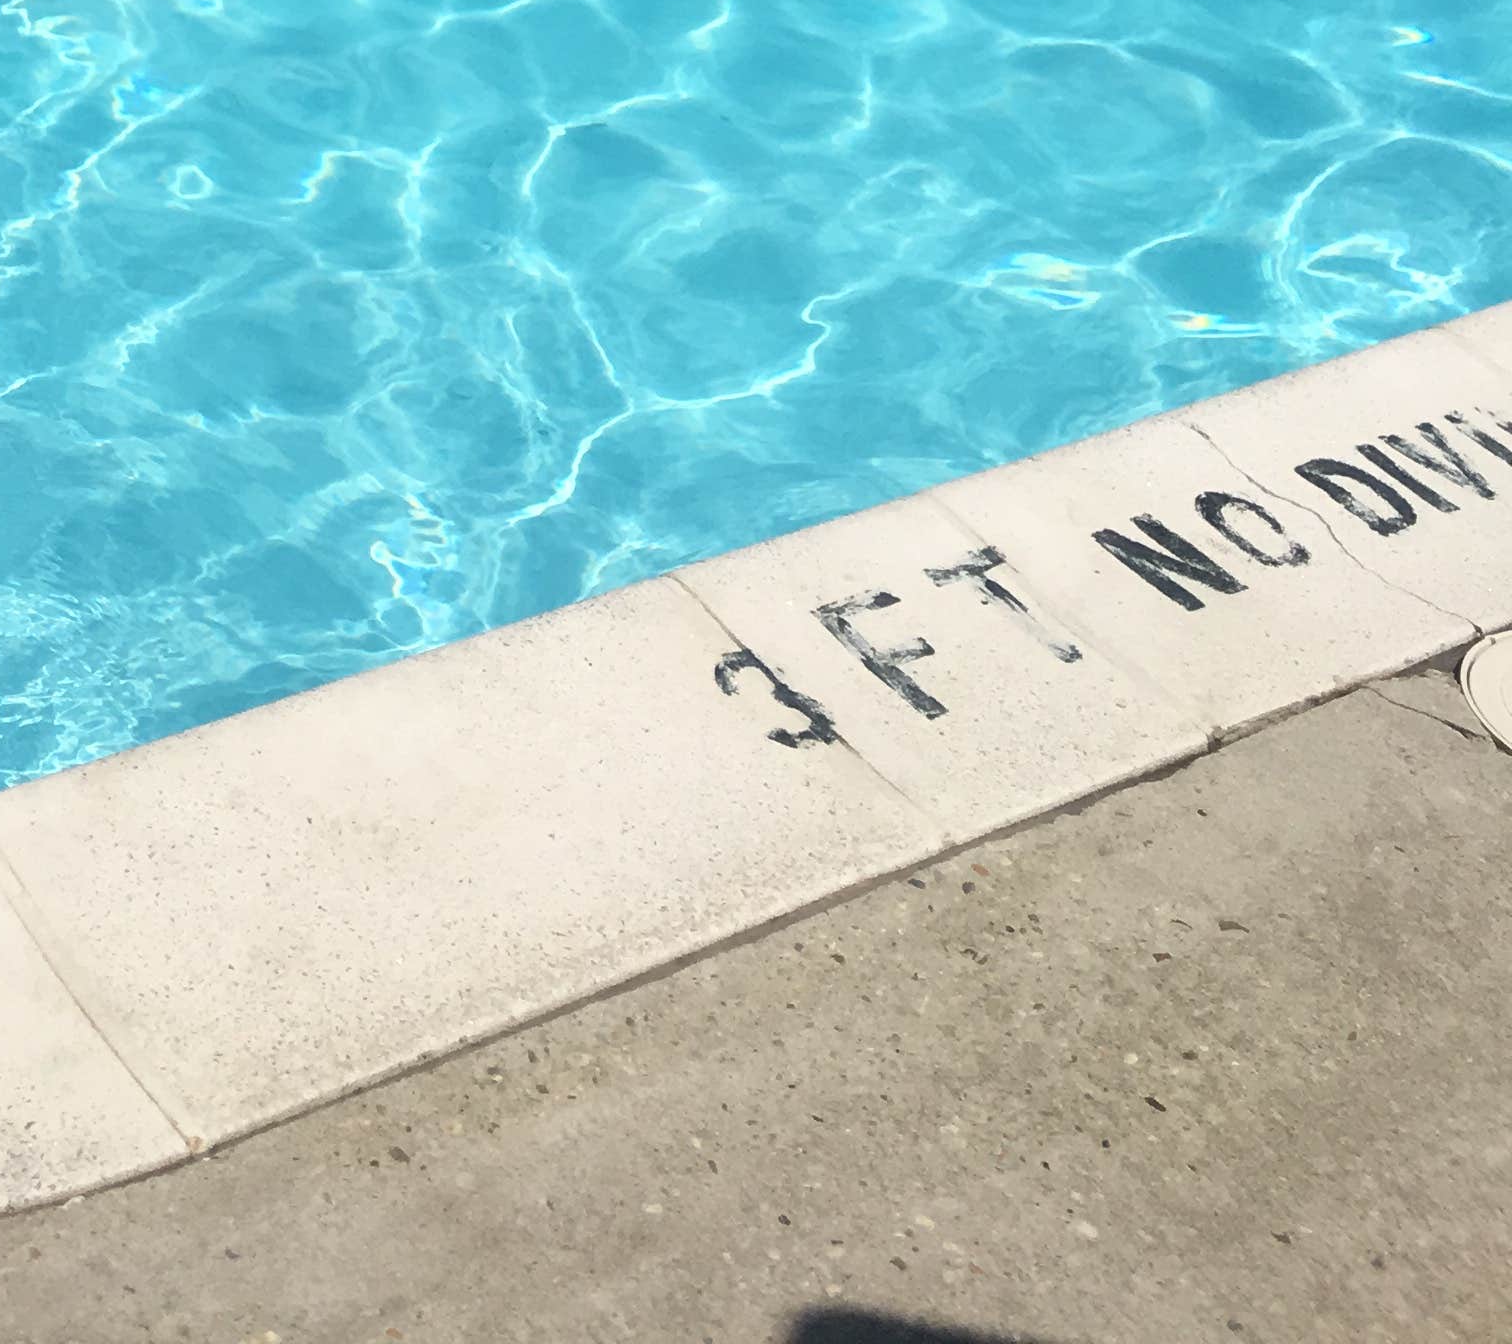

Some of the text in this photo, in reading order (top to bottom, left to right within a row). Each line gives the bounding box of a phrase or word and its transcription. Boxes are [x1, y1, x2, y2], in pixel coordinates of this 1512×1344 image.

[713, 404, 1512, 749] 3 FT NO DIVI
